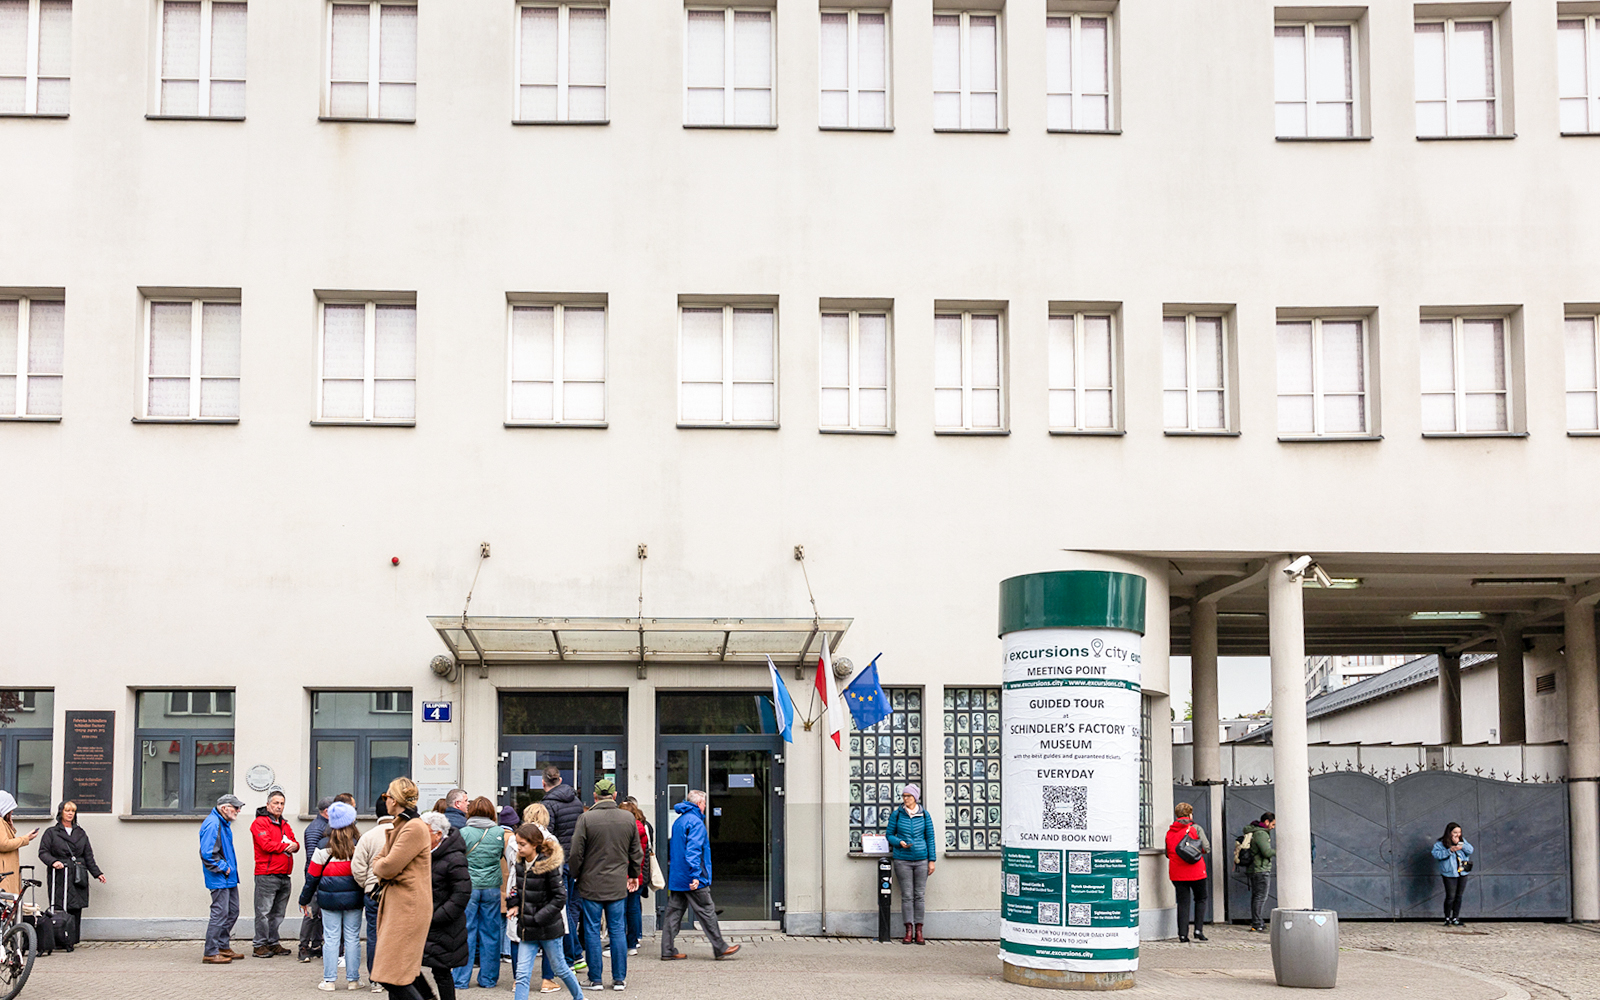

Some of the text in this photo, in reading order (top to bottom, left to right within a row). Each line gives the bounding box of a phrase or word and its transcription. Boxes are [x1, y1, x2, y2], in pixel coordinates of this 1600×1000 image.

[1009, 646, 1089, 661] excursions
[1105, 646, 1128, 661] city
[1027, 666, 1107, 676] MEETING POINT
[1010, 680, 1064, 689] www.excursions.city
[1069, 680, 1126, 688] www.excursions.city
[1029, 699, 1105, 709] GUIDED TOUR
[430, 708, 440, 720] 4
[1010, 723, 1075, 735] SCHINDLER'S
[1079, 724, 1126, 735] FACTORY
[1040, 740, 1092, 749] MUSEUM
[1037, 769, 1095, 779] EVERYDAY
[1020, 833, 1112, 843] SCAN AND BOOK NOW!
[1035, 949, 1093, 958] www.excursions.city
